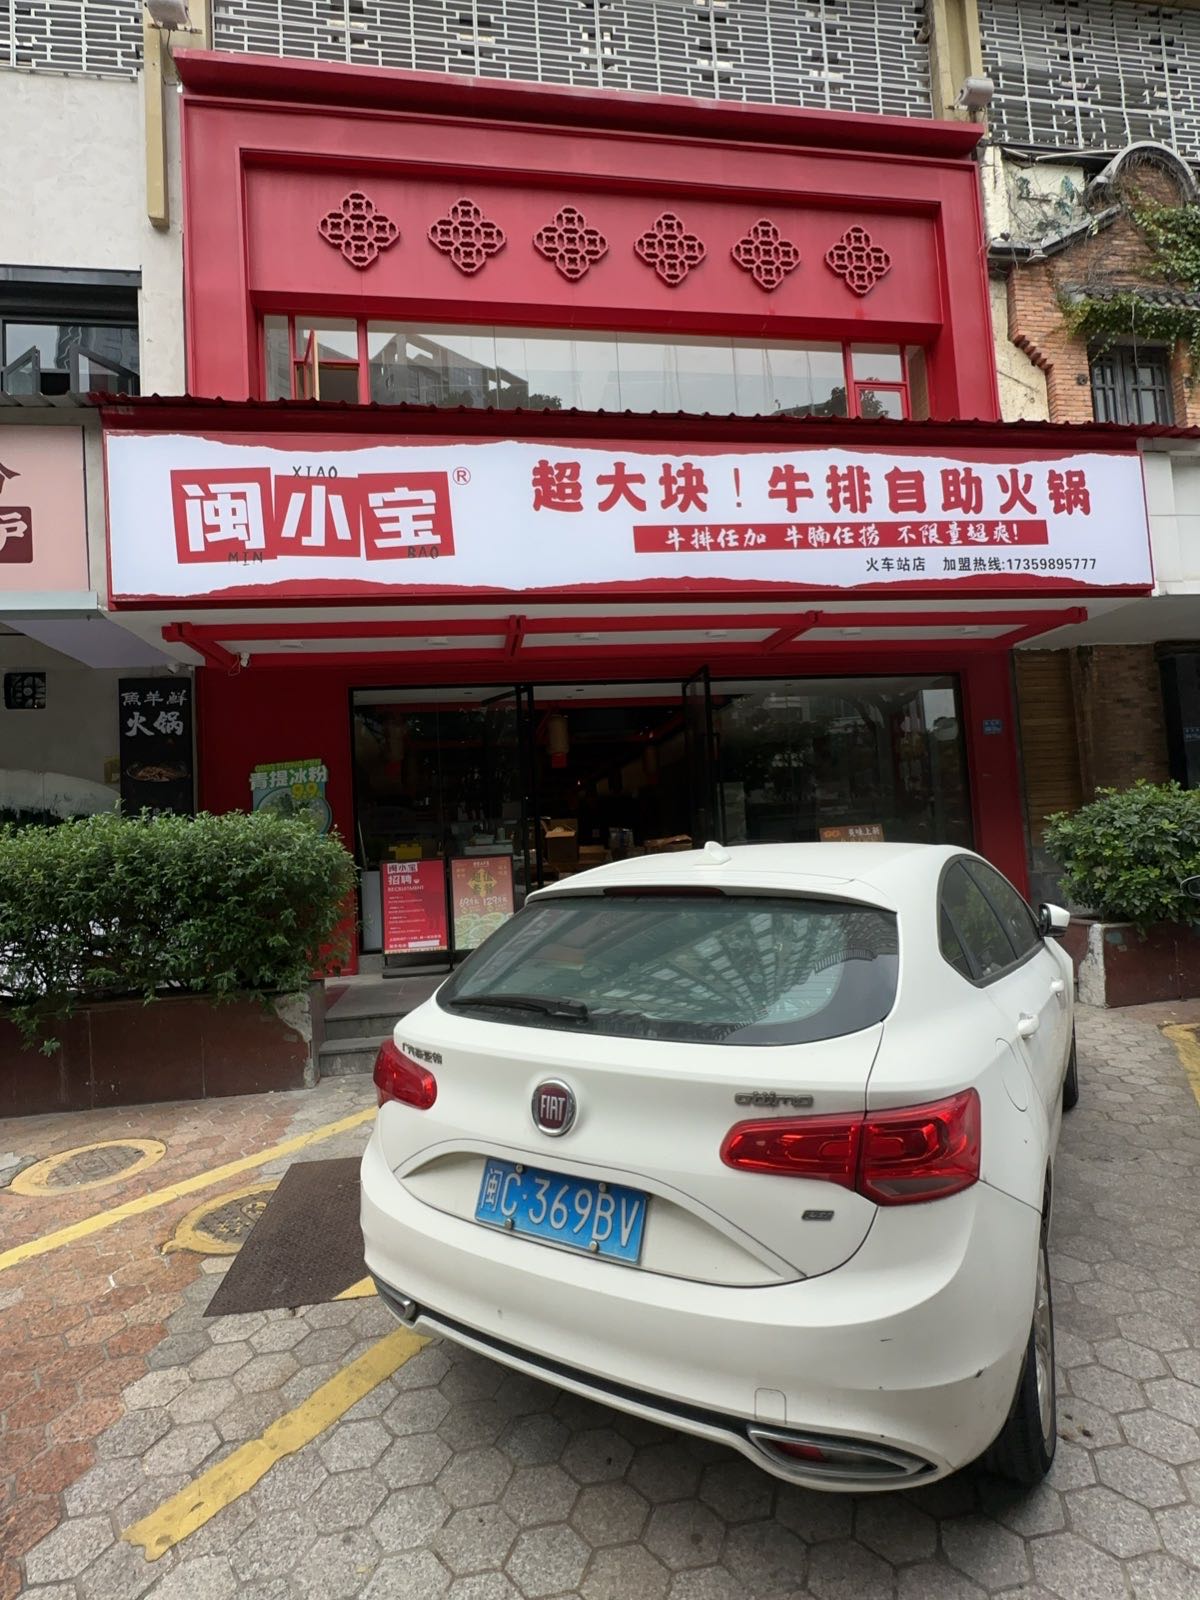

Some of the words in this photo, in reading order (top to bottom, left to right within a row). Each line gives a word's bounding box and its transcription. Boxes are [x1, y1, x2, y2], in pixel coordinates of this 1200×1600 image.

[292, 465, 339, 480] XIAO
[181, 481, 442, 552] 闽小宝
[664, 526, 767, 552] 牛排任加
[784, 522, 880, 549] 牛腩任捞
[227, 551, 264, 566] MIN
[407, 545, 440, 560] BAO
[866, 556, 926, 572] 火车站店
[125, 711, 183, 737] 火锅
[540, 1094, 566, 1121] FIAT
